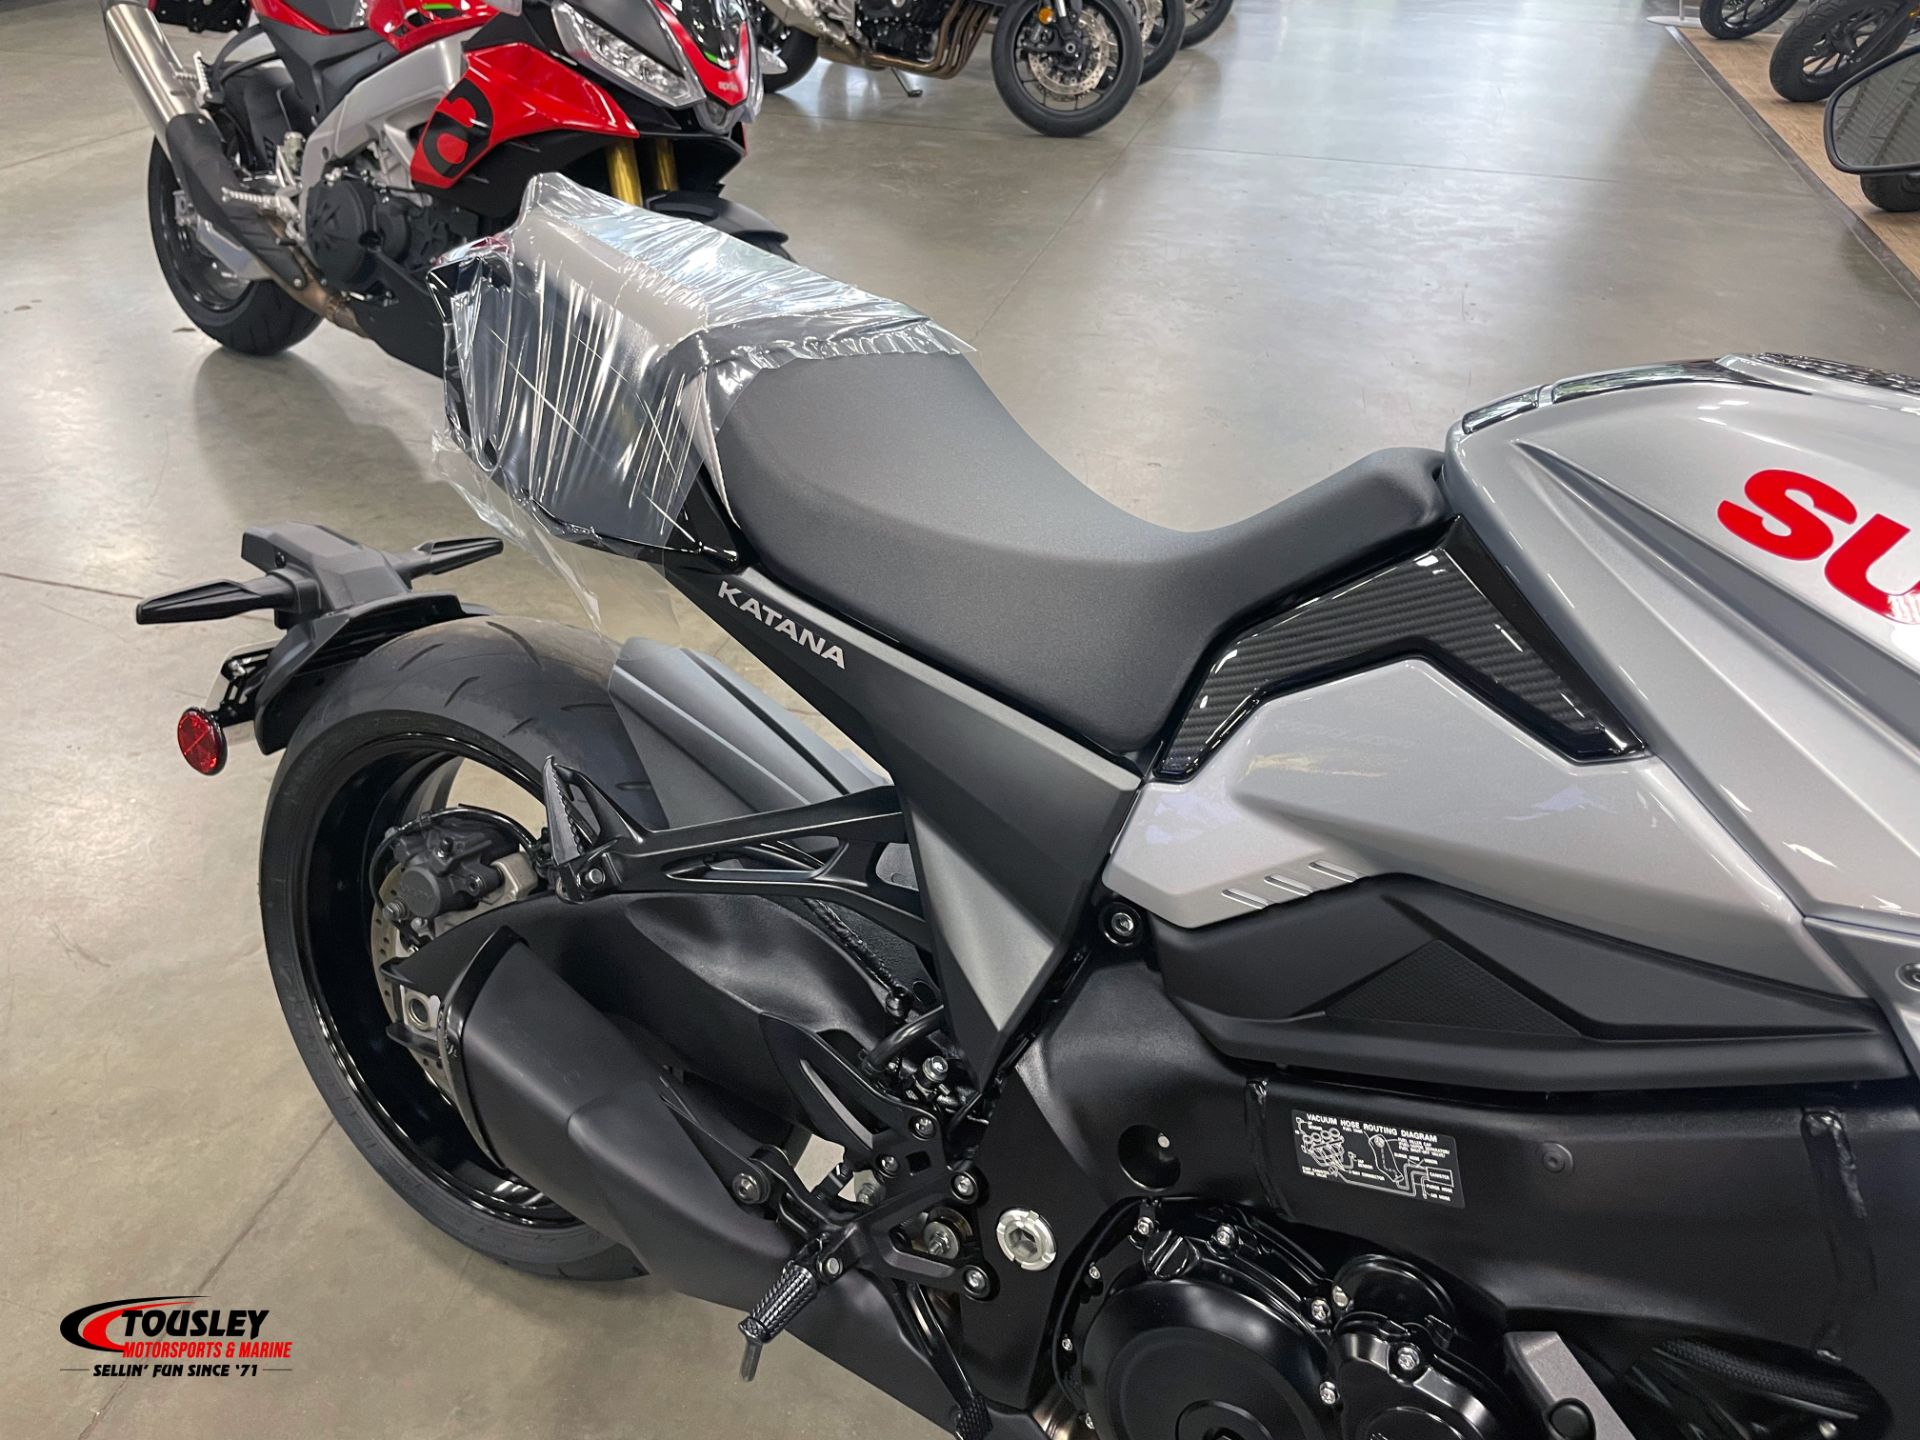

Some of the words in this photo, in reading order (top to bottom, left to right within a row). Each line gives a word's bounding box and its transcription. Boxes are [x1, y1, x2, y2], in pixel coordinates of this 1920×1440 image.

[718, 580, 845, 670] KATANA
[1306, 1113, 1338, 1126] VACUUM
[1340, 1119, 1360, 1129] HOSE
[1363, 1123, 1397, 1136] ROUTING
[1400, 1129, 1438, 1143] DIAGRAM
